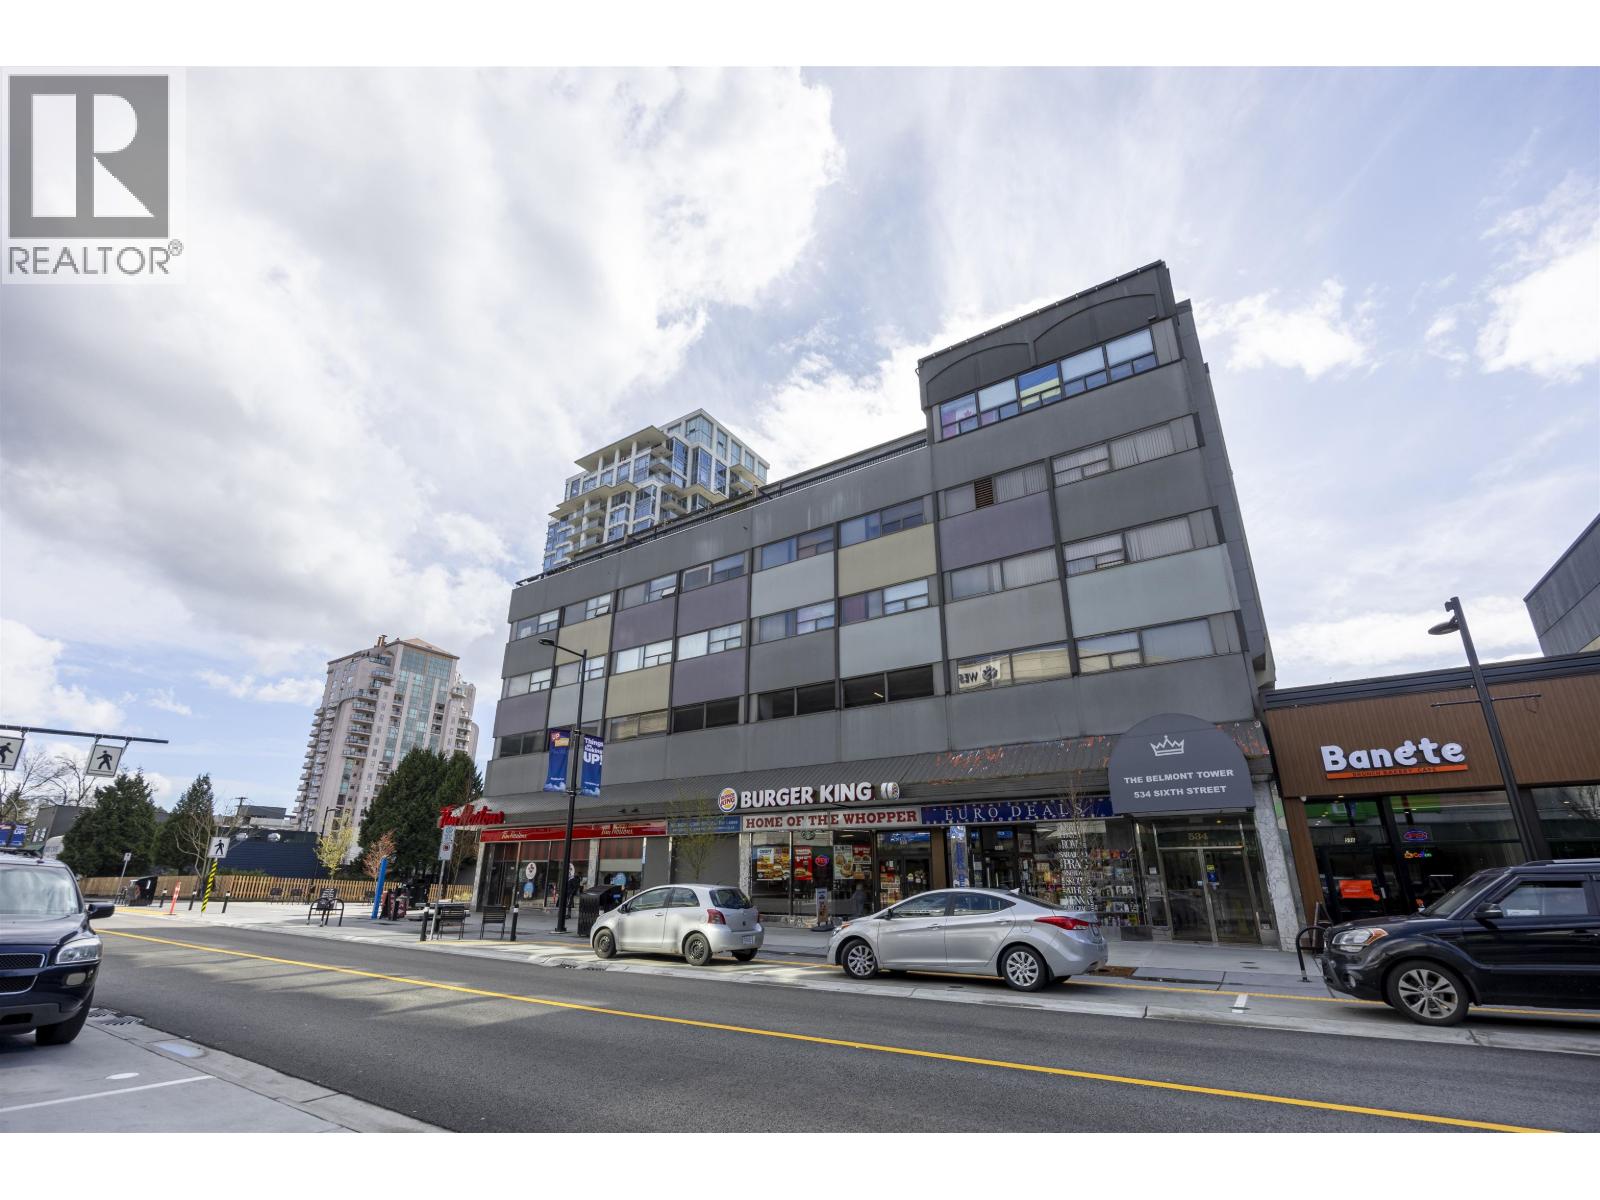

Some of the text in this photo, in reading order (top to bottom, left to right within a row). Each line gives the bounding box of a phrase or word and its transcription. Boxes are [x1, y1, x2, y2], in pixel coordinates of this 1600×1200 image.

[583, 751, 603, 766] UP!
[1123, 769, 1235, 784] THE BELMONT TOWER
[741, 786, 814, 809] BURGER
[820, 781, 873, 804] KING
[1134, 785, 1227, 799] 534 SIXTH STREET
[746, 815, 783, 829] HOME
[787, 815, 804, 827] OF
[809, 814, 839, 825] THE
[843, 810, 918, 825] WHOPPER
[945, 804, 1083, 821] EURO DEALS
